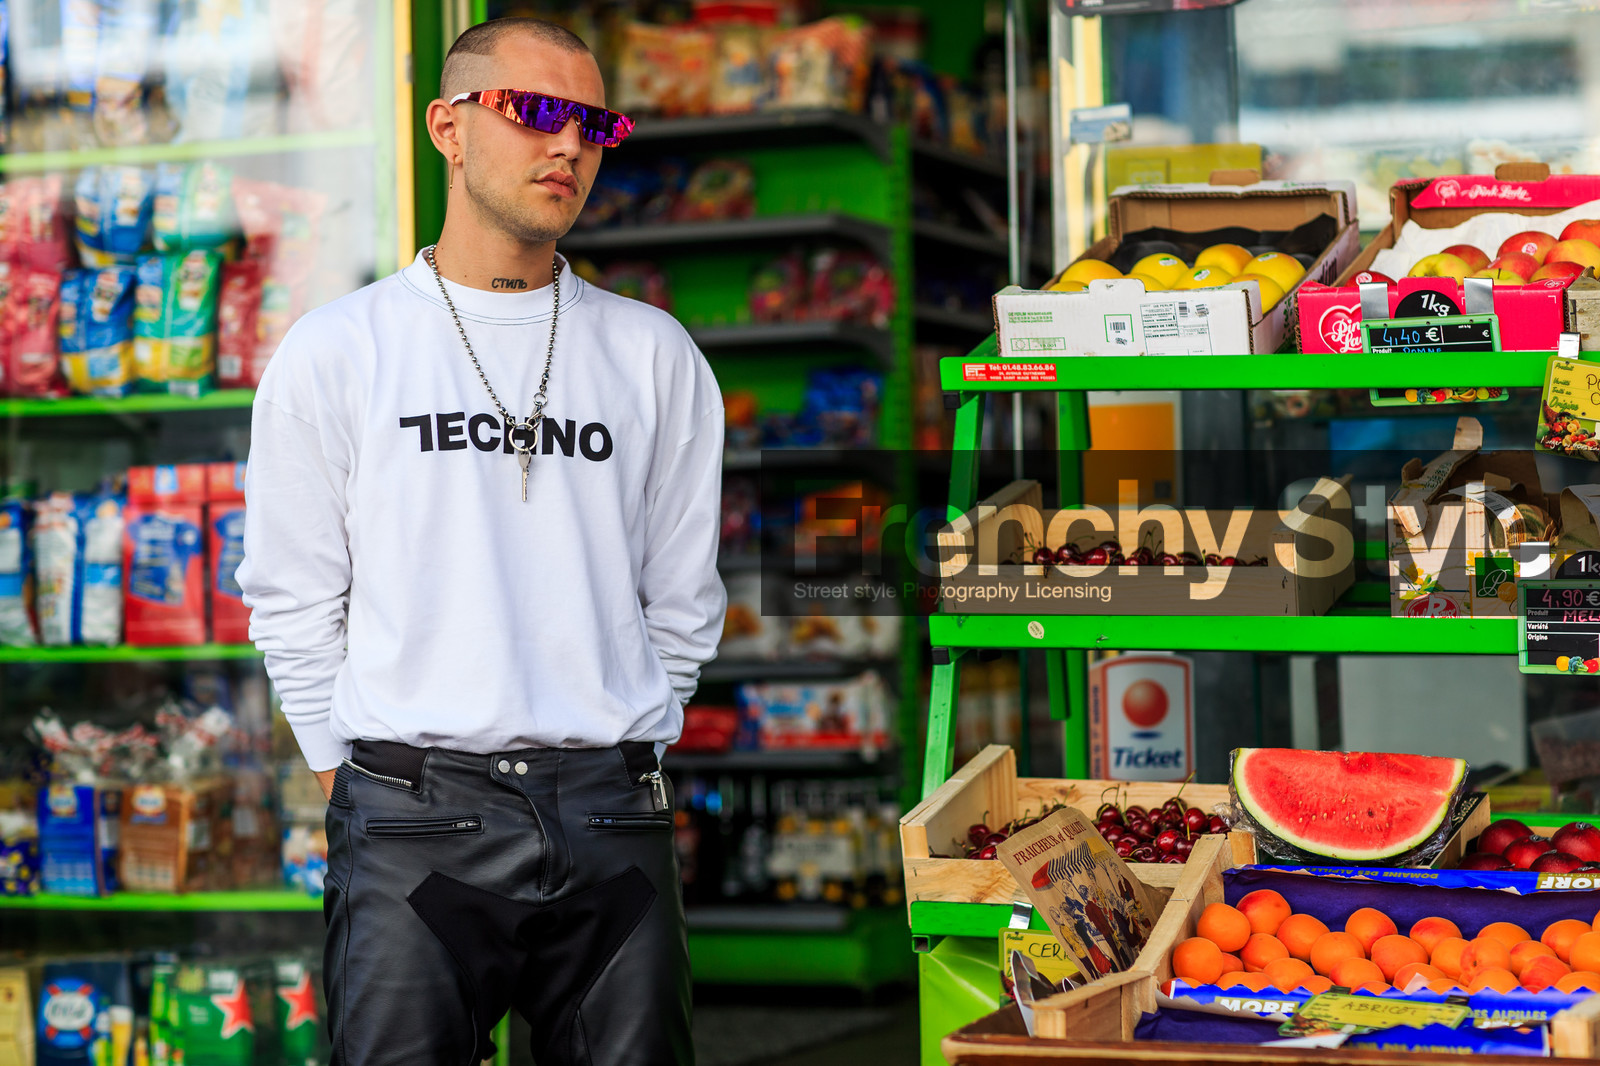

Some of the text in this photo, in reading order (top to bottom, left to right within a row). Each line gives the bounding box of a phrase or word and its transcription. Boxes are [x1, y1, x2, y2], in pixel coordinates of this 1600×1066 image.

[1420, 294, 1450, 317] 1kg
[1577, 554, 1600, 576] 1k
[1542, 589, 1584, 608] 4,90
[1527, 633, 1548, 642] Origine
[1113, 746, 1183, 769] Ticket
[1382, 871, 1439, 880] DOMAINE
